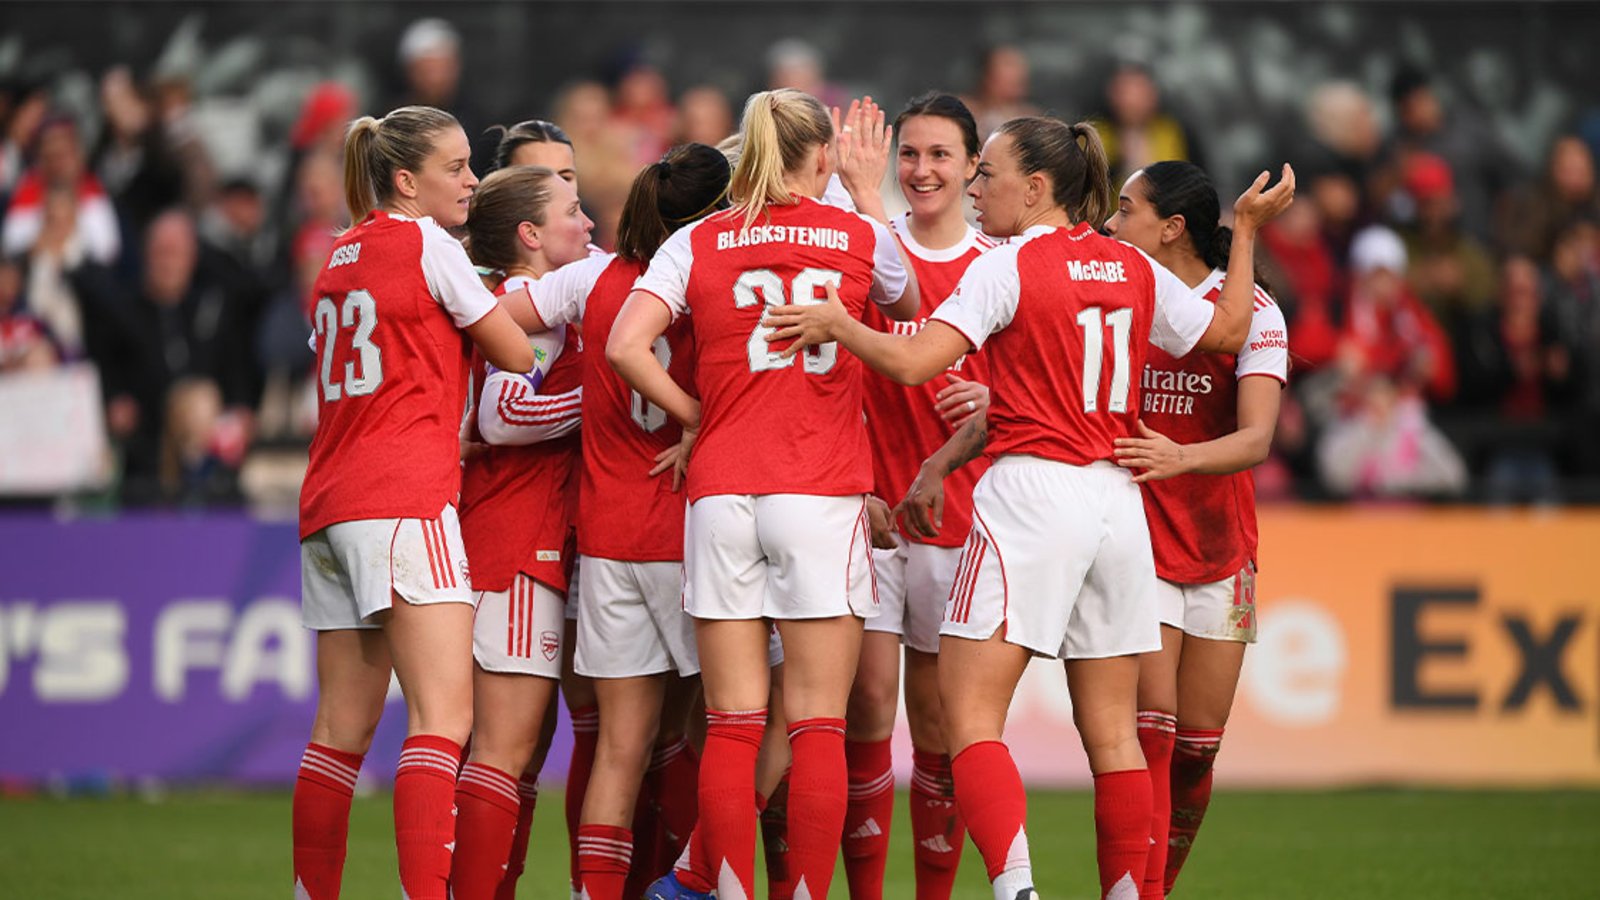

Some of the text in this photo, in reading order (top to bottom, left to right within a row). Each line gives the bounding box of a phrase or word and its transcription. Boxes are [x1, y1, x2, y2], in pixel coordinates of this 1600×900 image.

[717, 225, 849, 251] BLACKSTENIUS
[1066, 260, 1127, 282] McCABE
[315, 289, 384, 403] 23
[1260, 330, 1284, 340] VISIT
[1076, 306, 1134, 414] 11
[1140, 363, 1212, 394] irates
[1143, 392, 1194, 415] BETTER
[154, 598, 314, 704] FA
[1389, 583, 1600, 716] Ex
